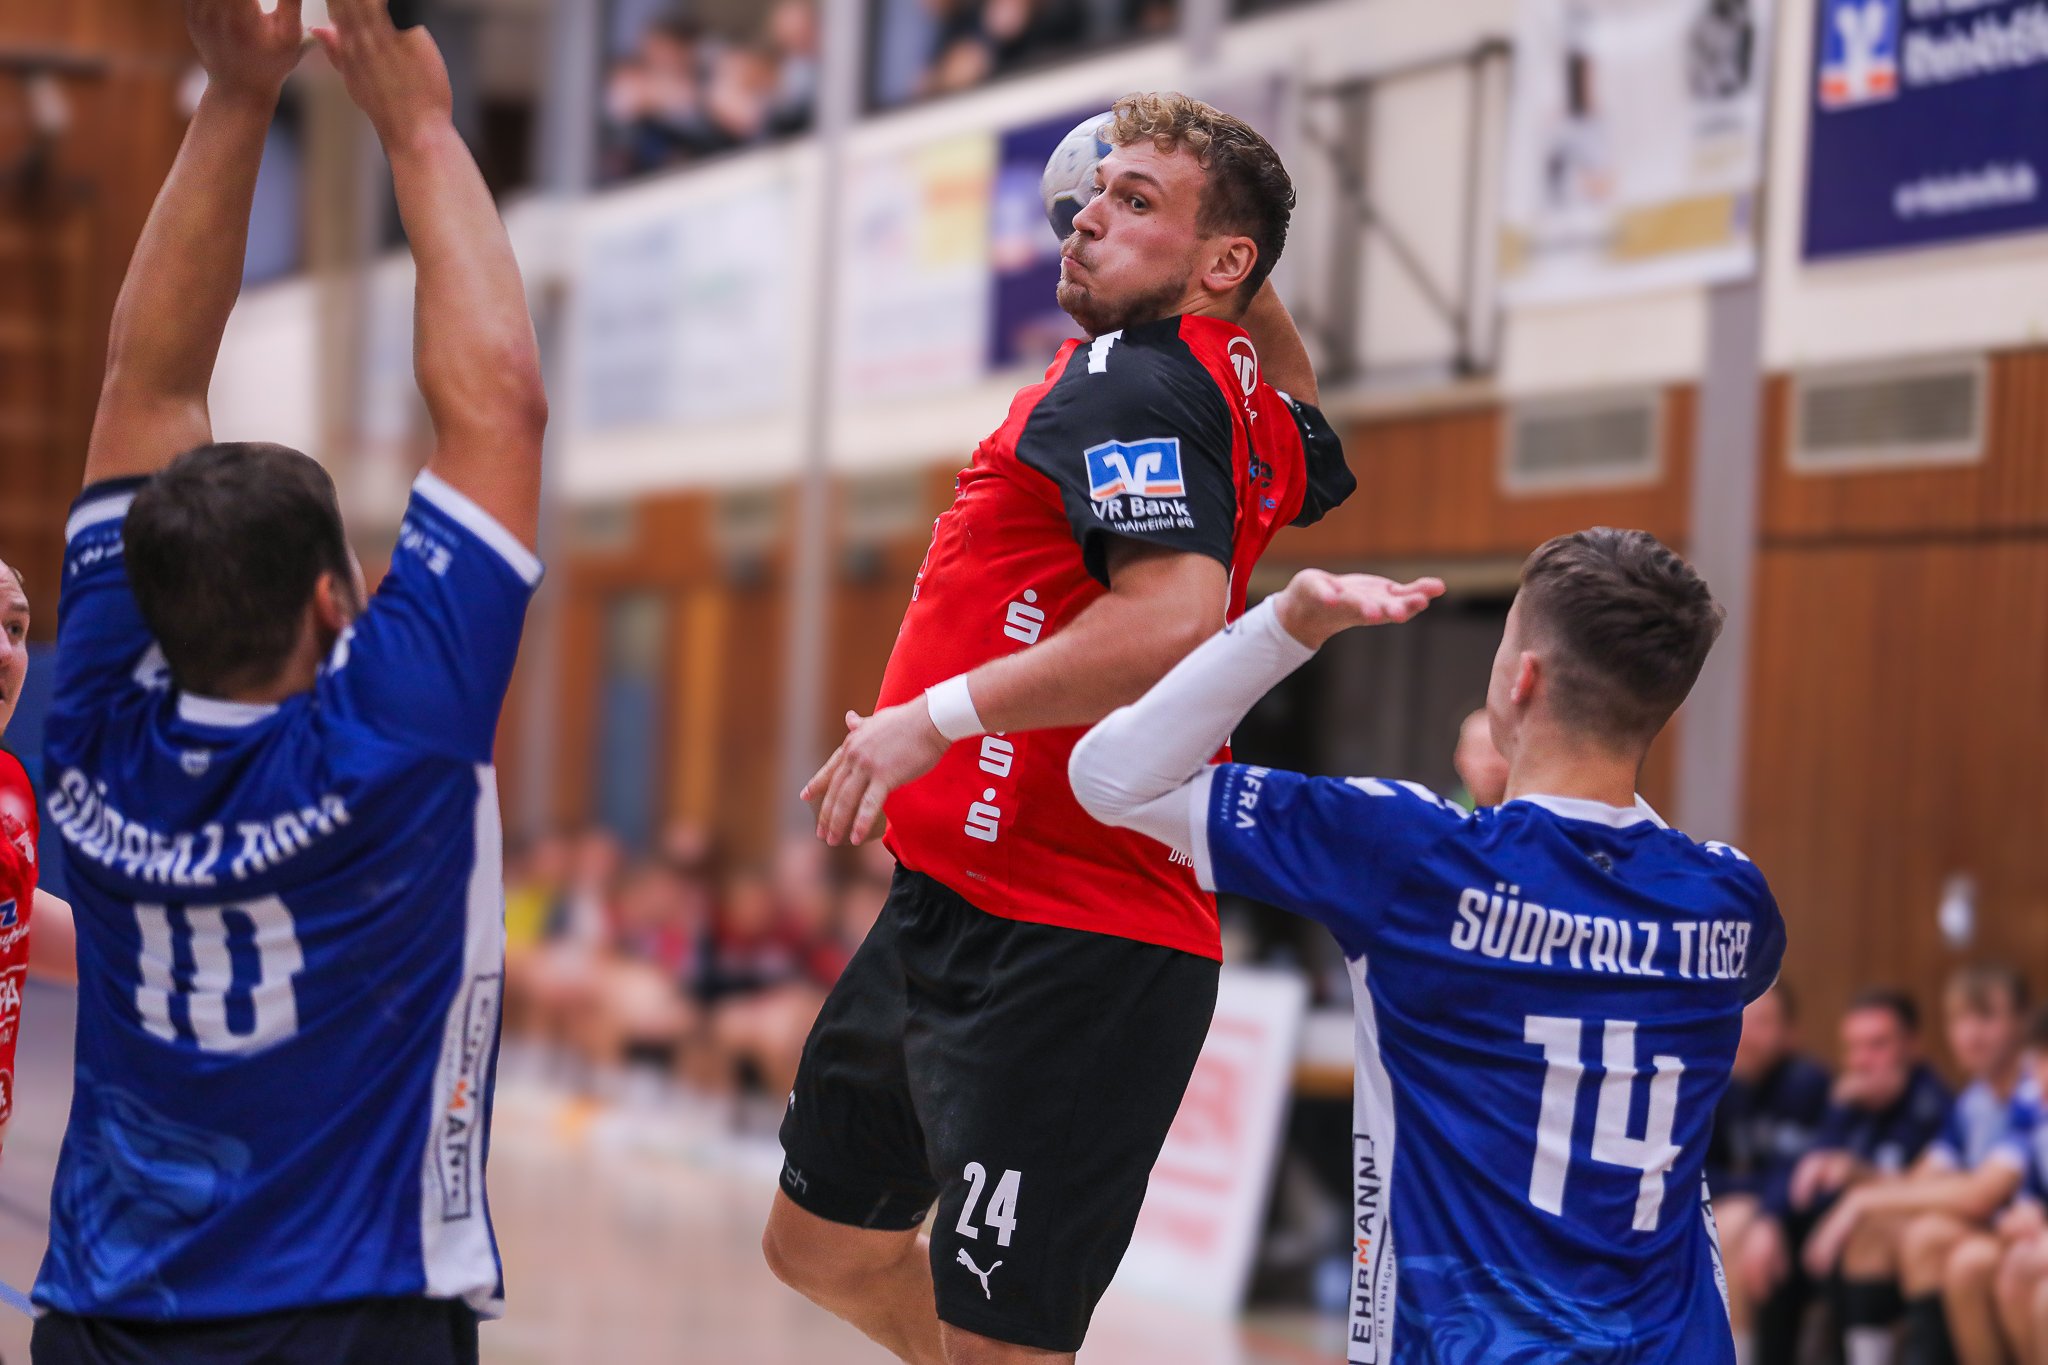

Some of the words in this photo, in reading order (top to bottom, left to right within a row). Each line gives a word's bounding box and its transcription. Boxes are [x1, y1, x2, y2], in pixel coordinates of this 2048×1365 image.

[1090, 498, 1124, 521] VR
[1130, 497, 1190, 517] Bank
[135, 893, 305, 1057] 10
[1450, 882, 1664, 977] SÜDPFALZ
[1523, 1014, 1686, 1232] 14
[955, 1161, 1022, 1247] 24
